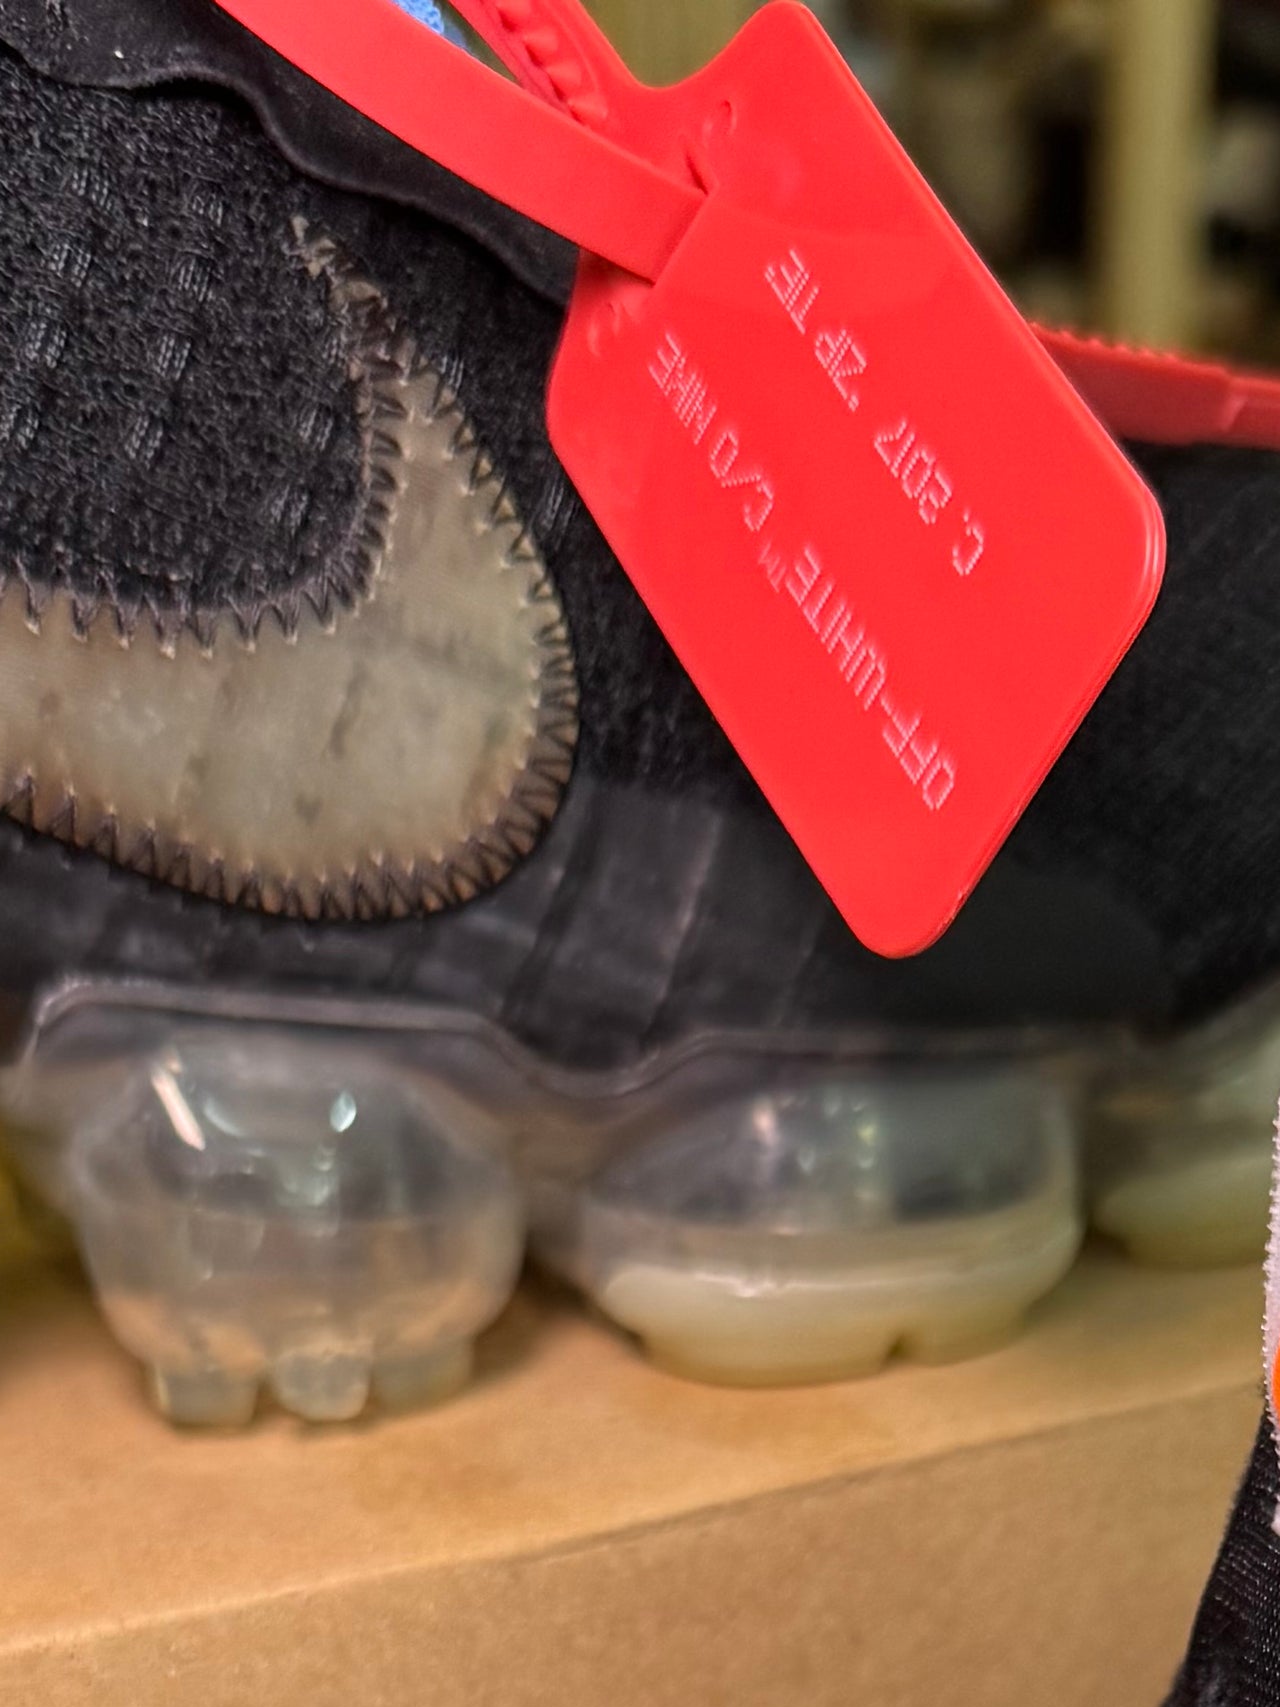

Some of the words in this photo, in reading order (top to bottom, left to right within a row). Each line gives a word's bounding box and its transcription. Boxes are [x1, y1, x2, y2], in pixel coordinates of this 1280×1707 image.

[647, 332, 717, 446] NIKE
[709, 430, 773, 532] C/O
[874, 418, 952, 525] 2017
